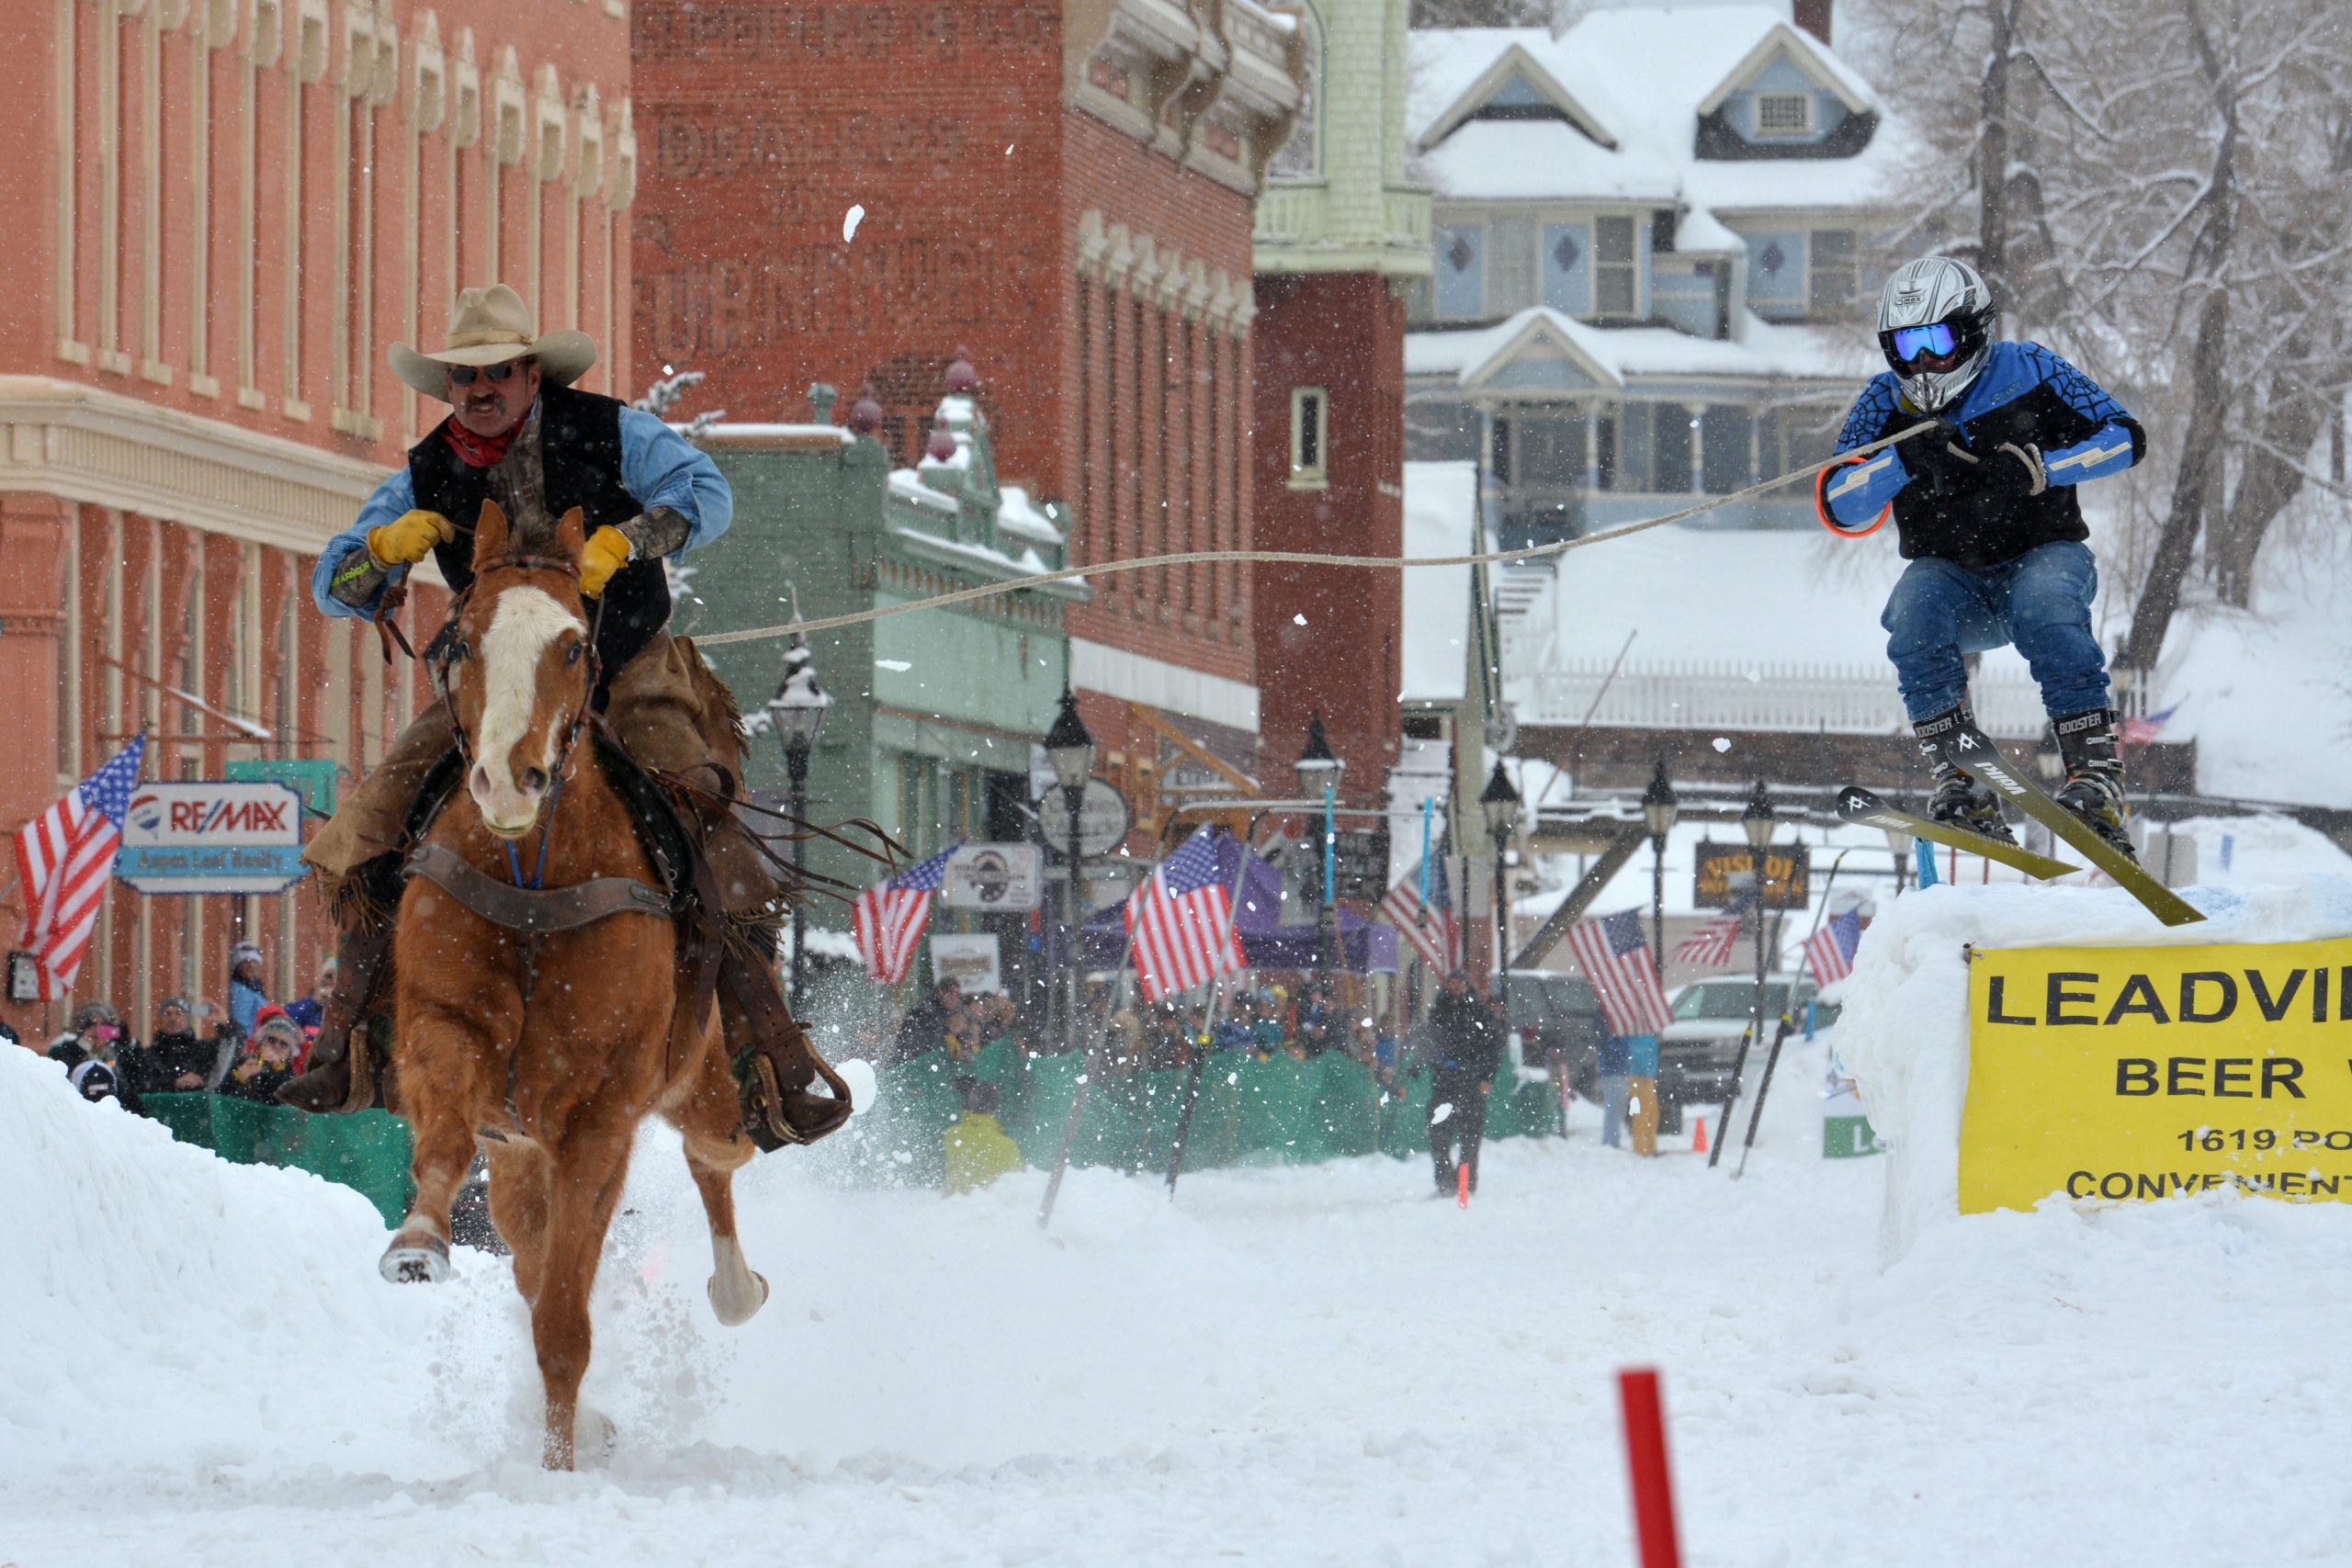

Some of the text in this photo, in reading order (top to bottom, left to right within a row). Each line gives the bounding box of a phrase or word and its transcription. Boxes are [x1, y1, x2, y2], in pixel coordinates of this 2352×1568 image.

[341, 561, 370, 583] ARMOUR
[2059, 713, 2101, 735] BOOSTER
[170, 798, 288, 834] RE/MAX
[139, 852, 282, 872] Aspen Leaf Realty
[1986, 965, 2352, 1027] LEADVI
[2115, 1056, 2308, 1100] BEER
[2177, 1128, 2352, 1152] 1619 PO
[2066, 1170, 2352, 1200] CONVENIEN
